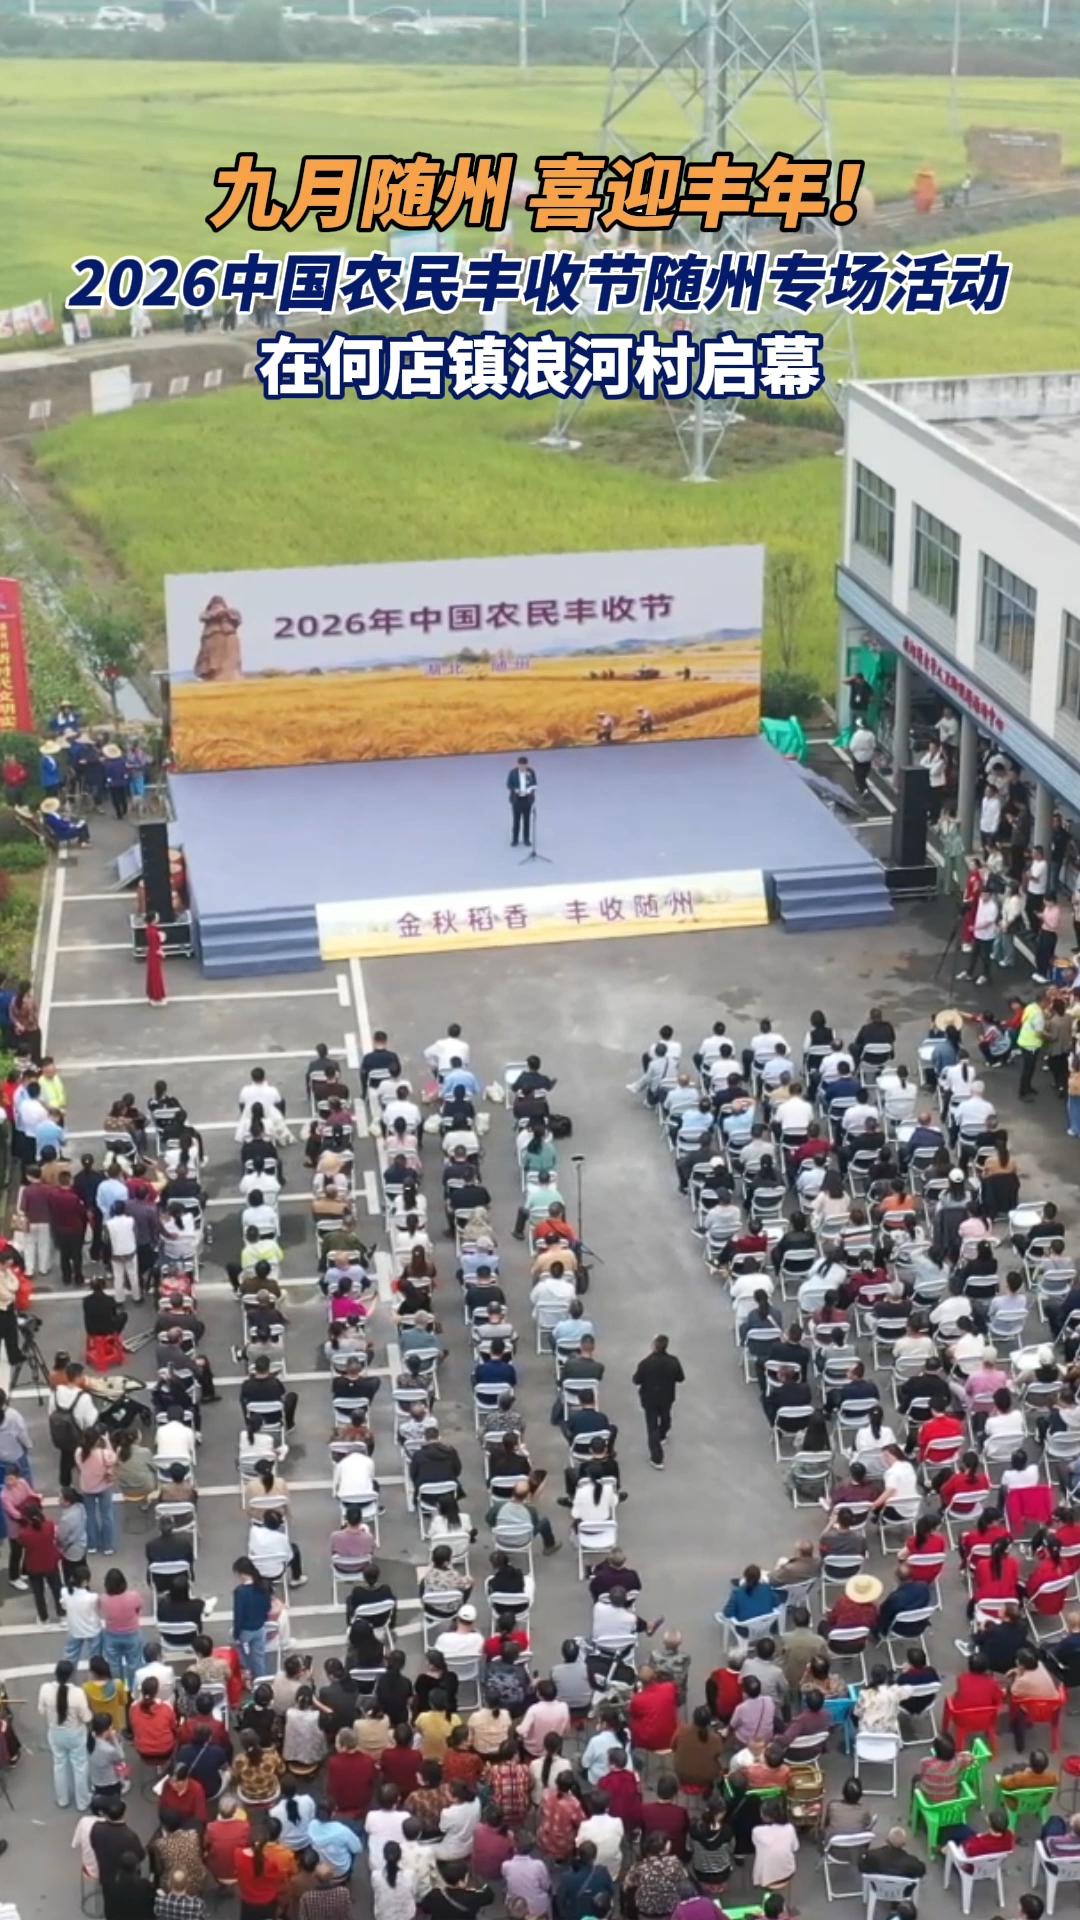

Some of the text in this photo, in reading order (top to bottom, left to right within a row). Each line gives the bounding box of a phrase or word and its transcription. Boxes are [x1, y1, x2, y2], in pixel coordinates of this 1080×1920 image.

[273, 593, 675, 640] 2026年中国农民丰收节
[396, 889, 695, 939] 金秋稻香 丰收随州
